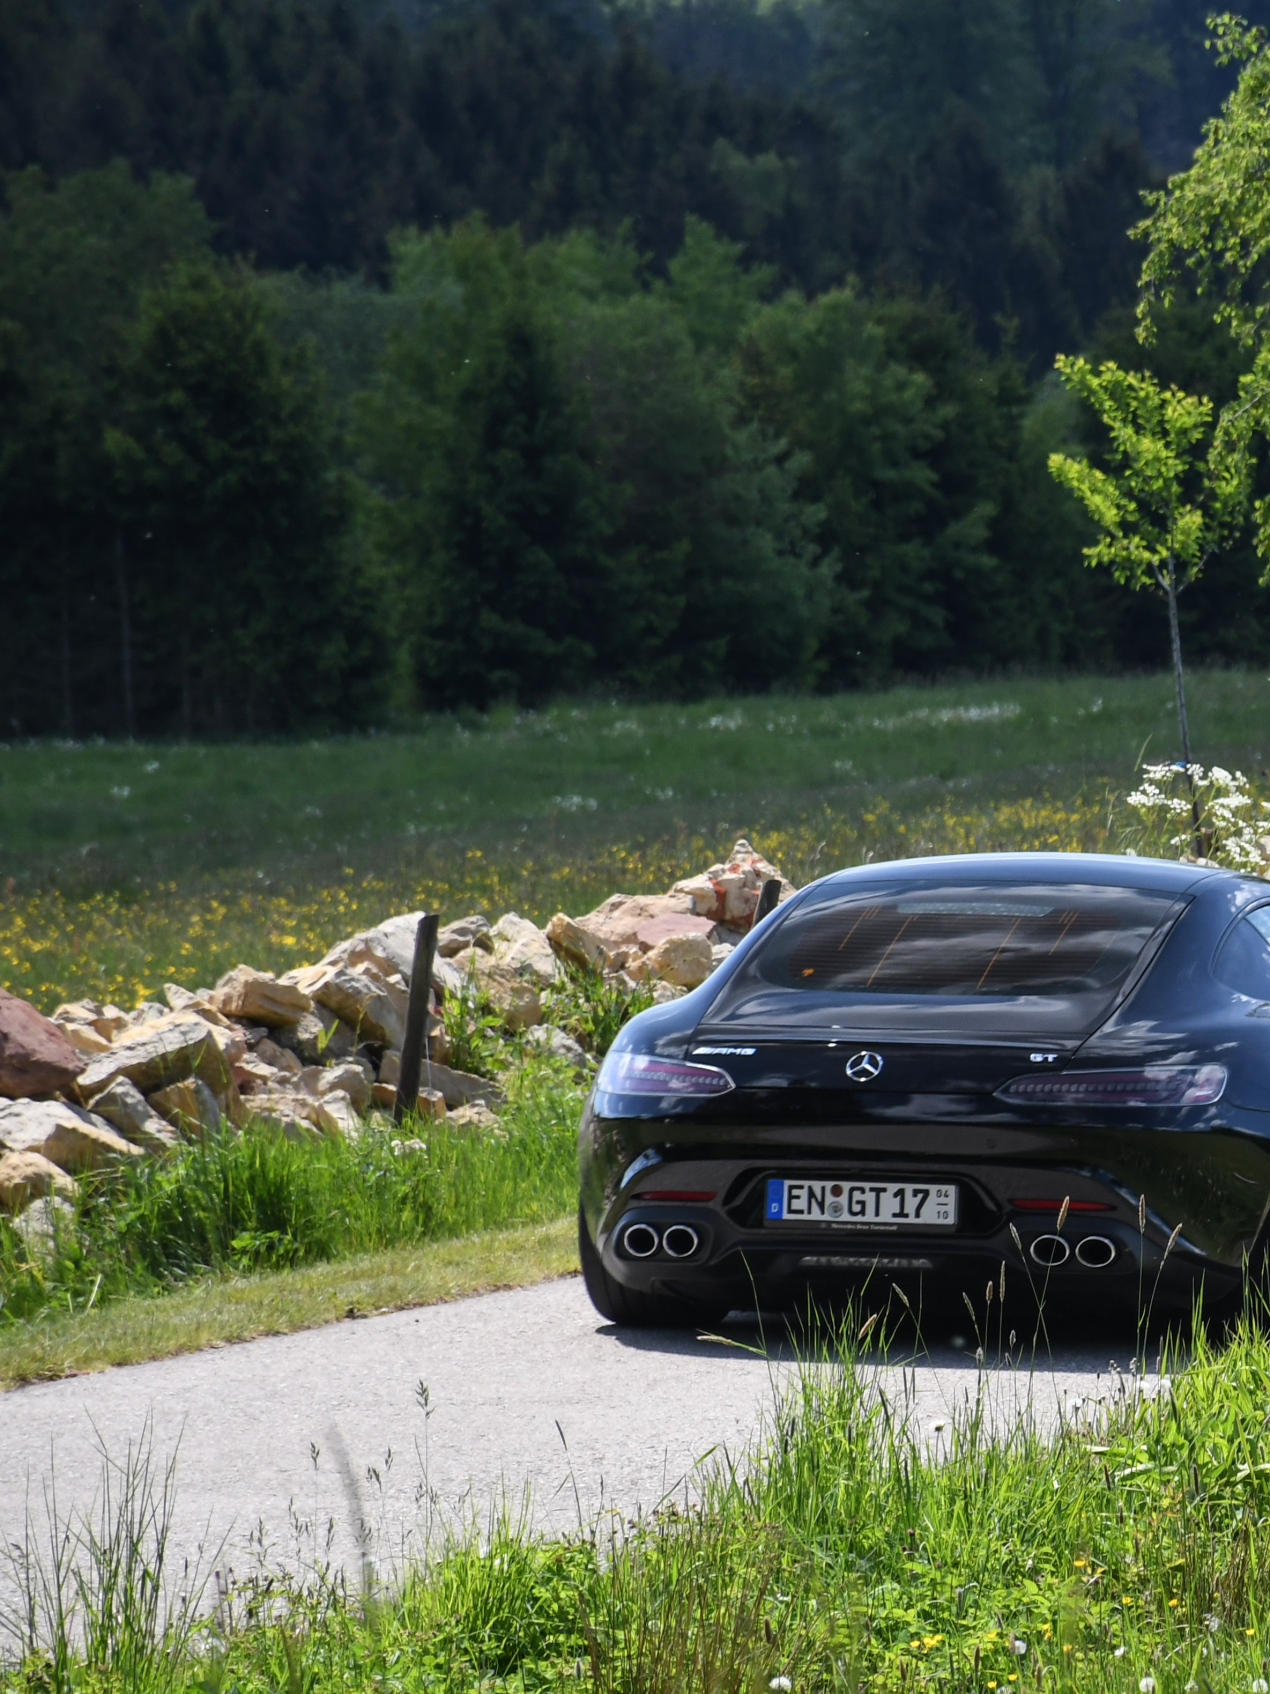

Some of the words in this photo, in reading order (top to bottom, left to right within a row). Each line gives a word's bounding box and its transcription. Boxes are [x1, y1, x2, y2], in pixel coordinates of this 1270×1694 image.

[711, 1047, 757, 1056] AMG
[1030, 1053, 1058, 1062] GT
[936, 1189, 950, 1198] 04
[786, 1184, 826, 1216] EN
[771, 1203, 779, 1213] D
[936, 1211, 949, 1220] 10
